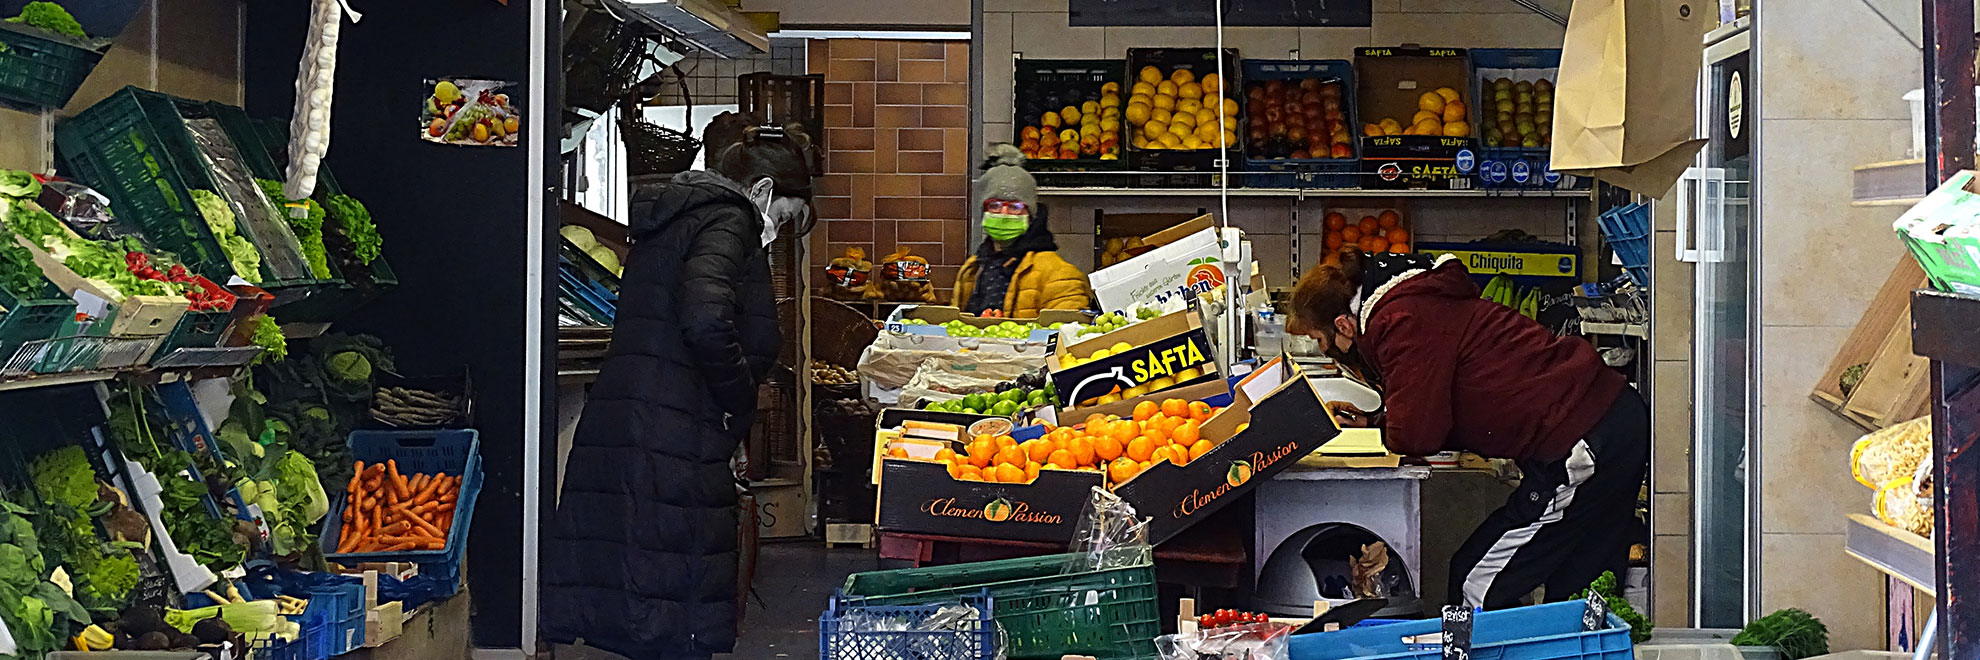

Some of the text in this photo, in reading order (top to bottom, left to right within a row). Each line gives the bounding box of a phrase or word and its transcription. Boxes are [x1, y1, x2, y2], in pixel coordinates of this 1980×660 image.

[1365, 49, 1392, 57] SAFTA
[1374, 137, 1401, 146] SAFTA
[1412, 164, 1458, 182] SAFTA
[1470, 253, 1523, 272] Chiquita
[1132, 337, 1205, 382] SAFTA
[1173, 441, 1298, 518] Clemen Passion
[921, 498, 1063, 524] Clemen Passion
